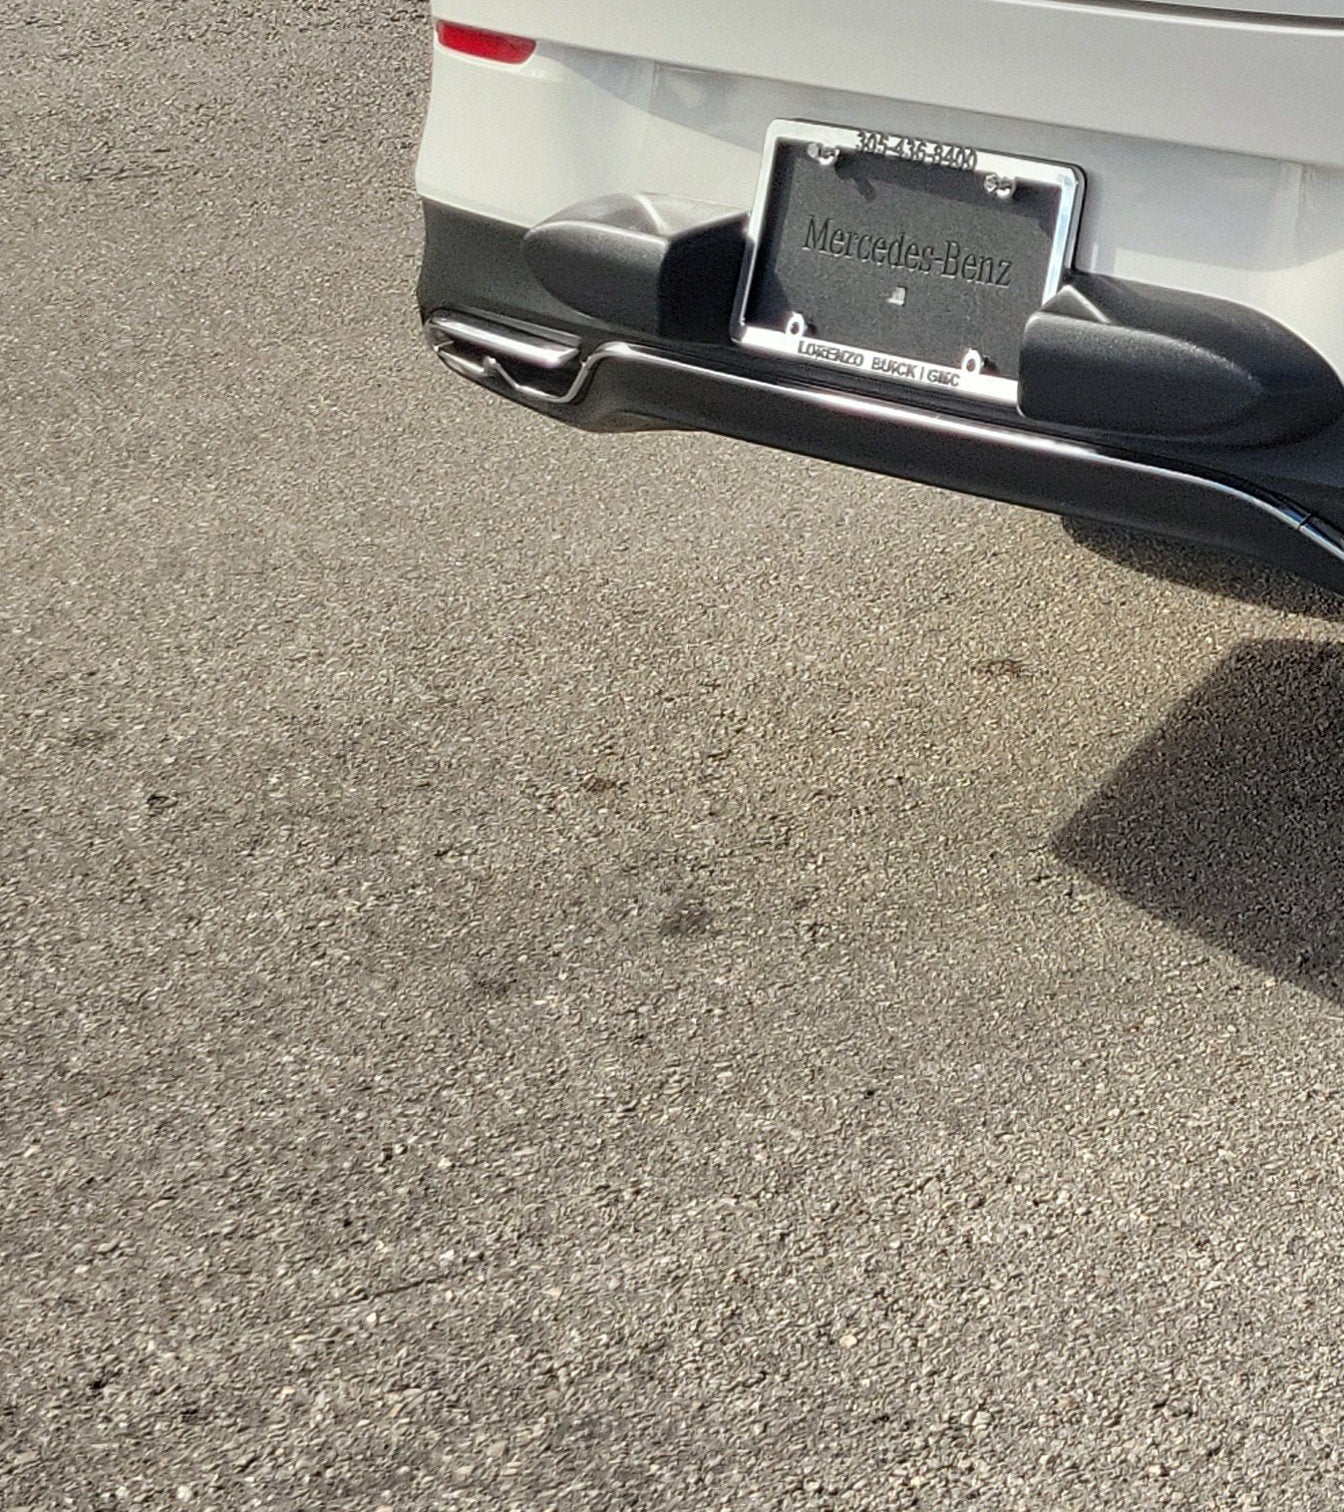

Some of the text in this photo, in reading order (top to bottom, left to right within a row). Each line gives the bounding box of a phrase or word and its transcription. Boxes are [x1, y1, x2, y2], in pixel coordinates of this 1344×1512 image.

[801, 214, 1013, 289] Mercedes-Benz
[797, 340, 961, 387] LORENZO BUICK GMC
